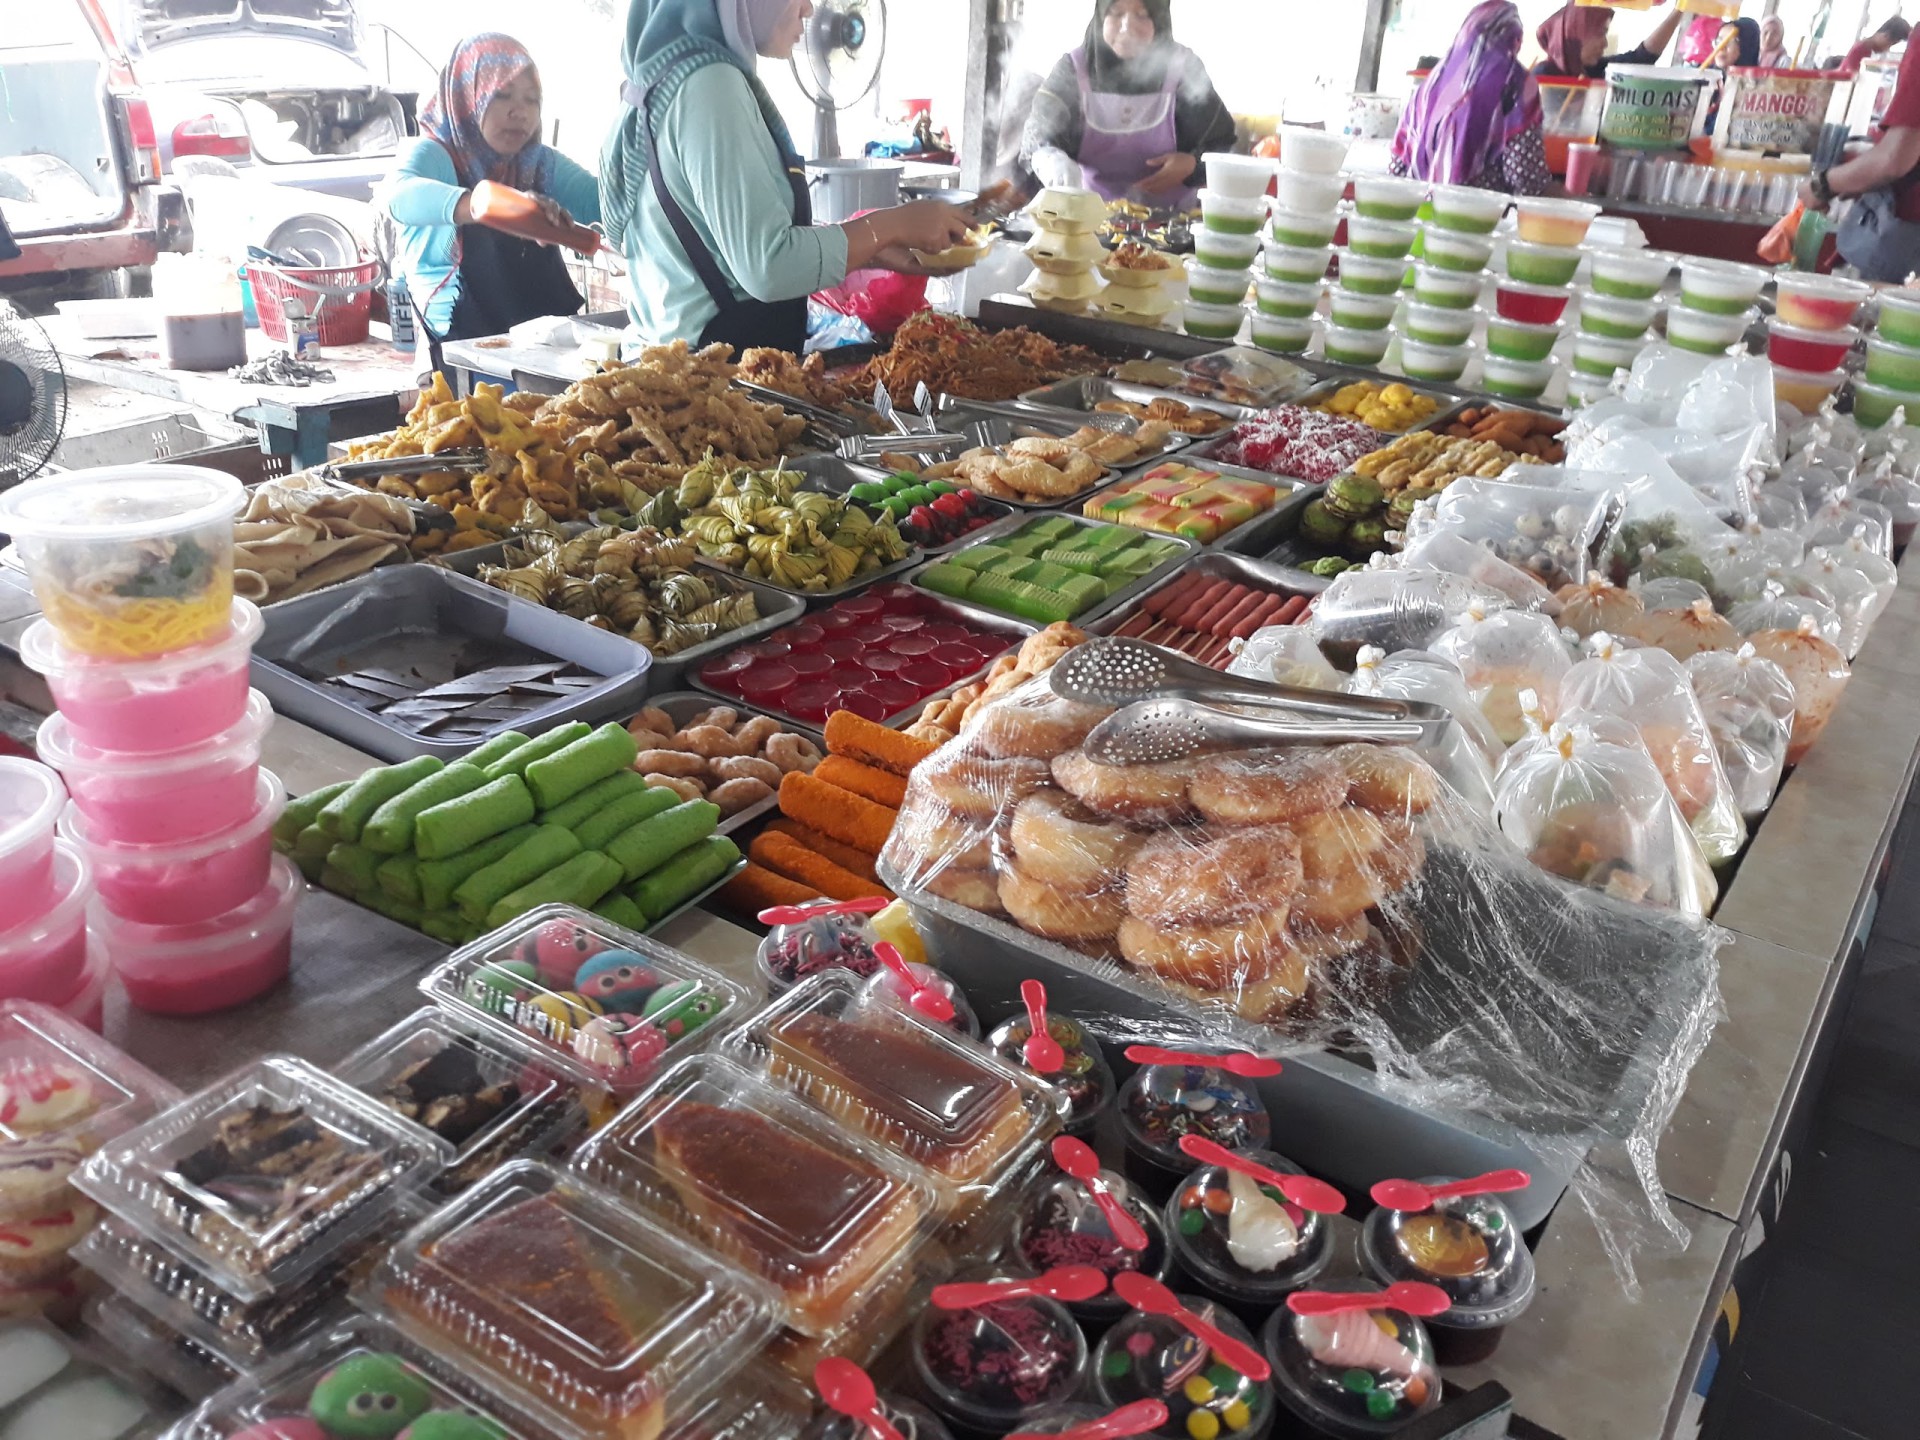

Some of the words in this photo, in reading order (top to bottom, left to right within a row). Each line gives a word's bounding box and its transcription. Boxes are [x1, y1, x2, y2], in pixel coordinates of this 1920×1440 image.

[1611, 86, 1655, 107] MILO
[1661, 89, 1693, 109] AIS
[1743, 92, 1818, 115] MANGGA
